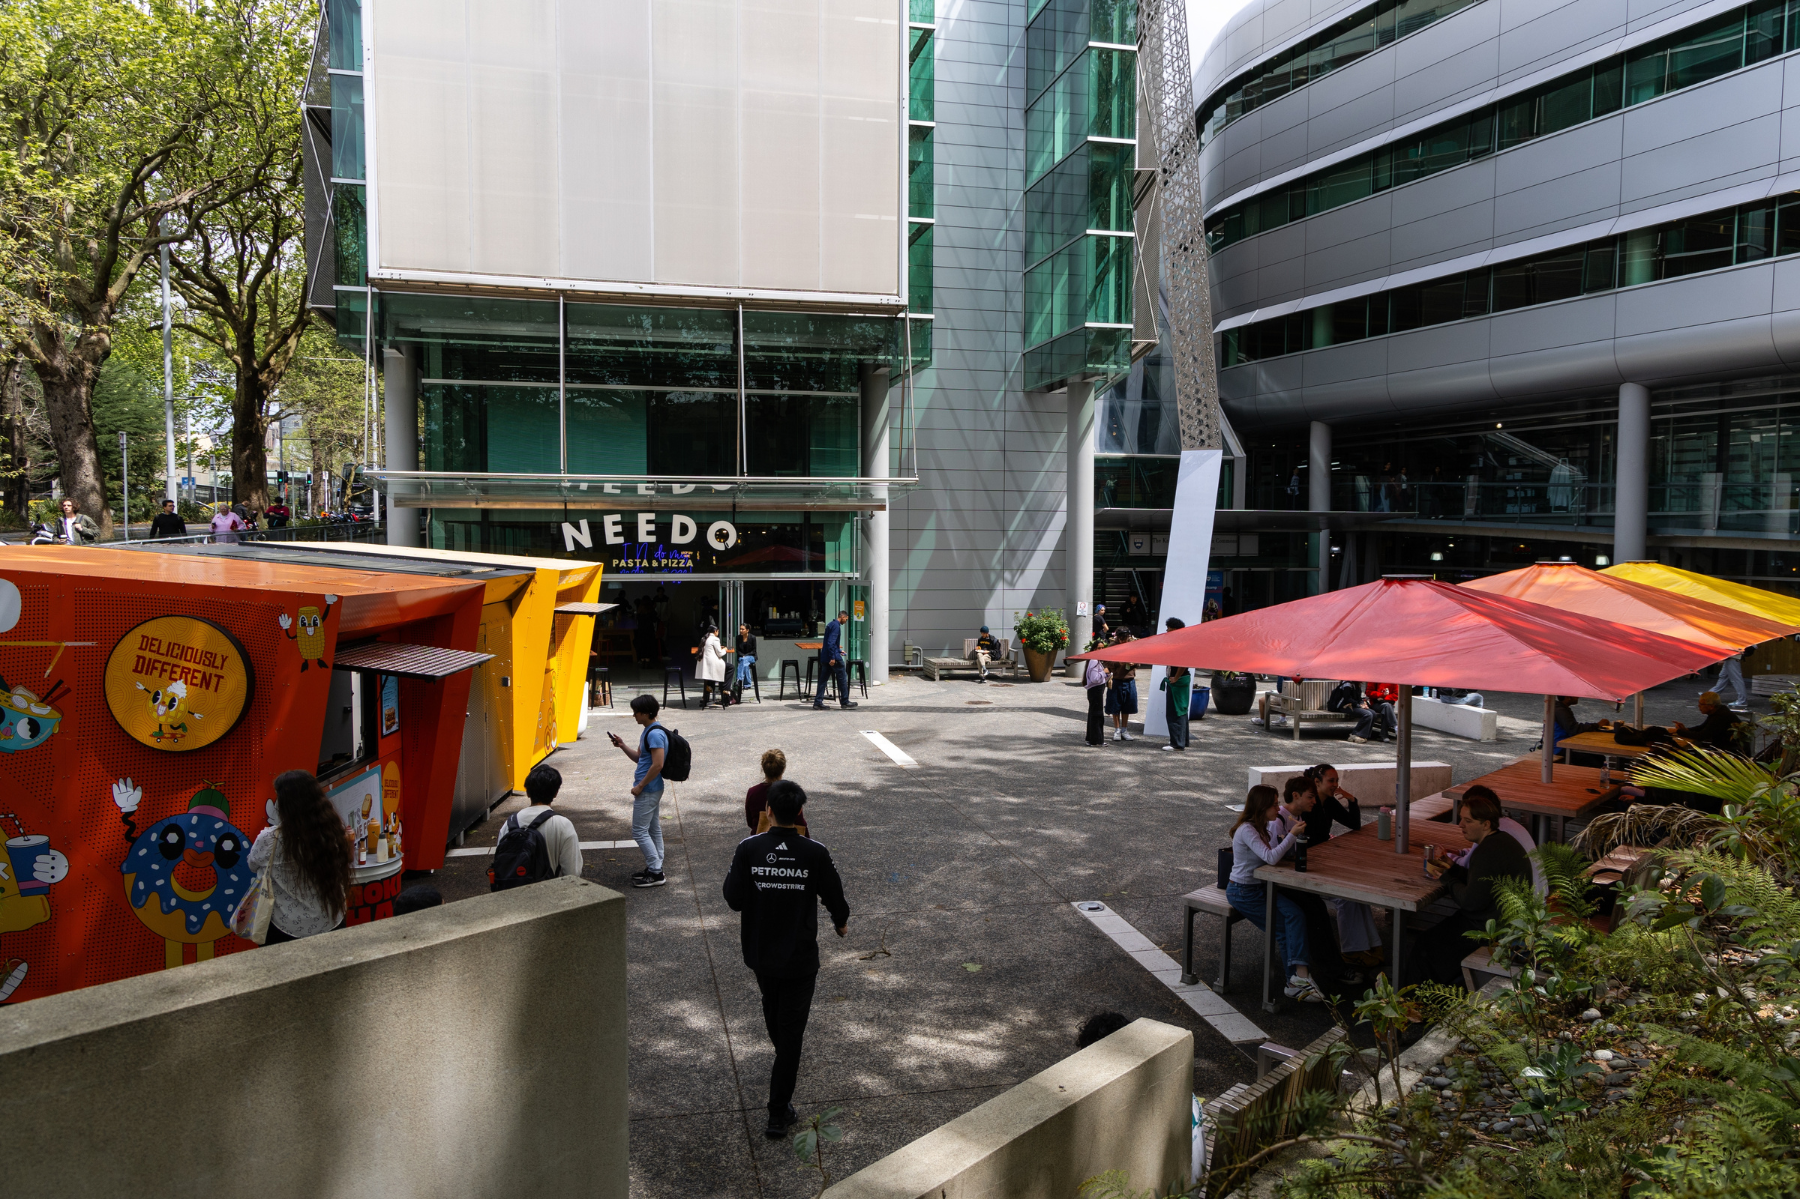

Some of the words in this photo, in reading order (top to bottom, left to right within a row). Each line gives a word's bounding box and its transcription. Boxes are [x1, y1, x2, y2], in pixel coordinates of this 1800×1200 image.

[561, 512, 737, 552] NEEDO
[612, 559, 649, 567] PASTA
[652, 559, 658, 567] &
[661, 559, 693, 567] PIZZA
[138, 634, 229, 671] DELICIOUSLY
[132, 654, 225, 693] DIFFERENT
[751, 866, 809, 878] PETRONAS
[757, 882, 806, 891] CROWDSTRIKE
